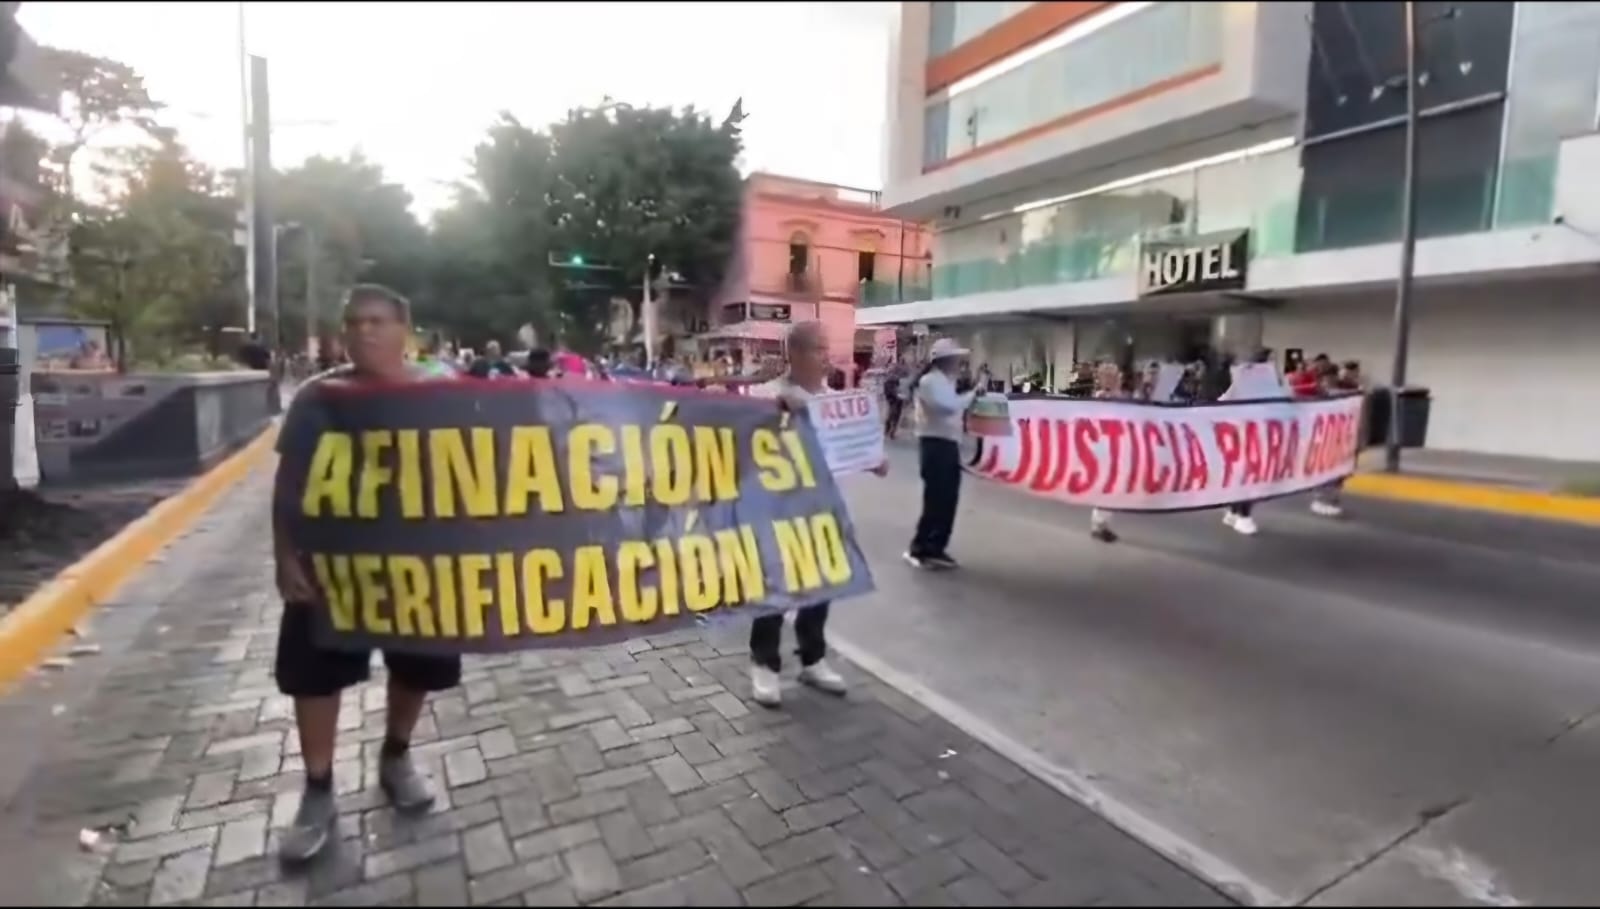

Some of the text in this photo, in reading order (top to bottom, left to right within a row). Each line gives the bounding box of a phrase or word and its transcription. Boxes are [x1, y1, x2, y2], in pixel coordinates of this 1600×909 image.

[1143, 243, 1239, 288] HOTEL
[302, 402, 739, 518] AFINACIÓN
[993, 418, 1209, 495] JUSTICIA
[1213, 420, 1299, 489] PARA
[312, 510, 852, 637] VERIFICACIÓN NO
